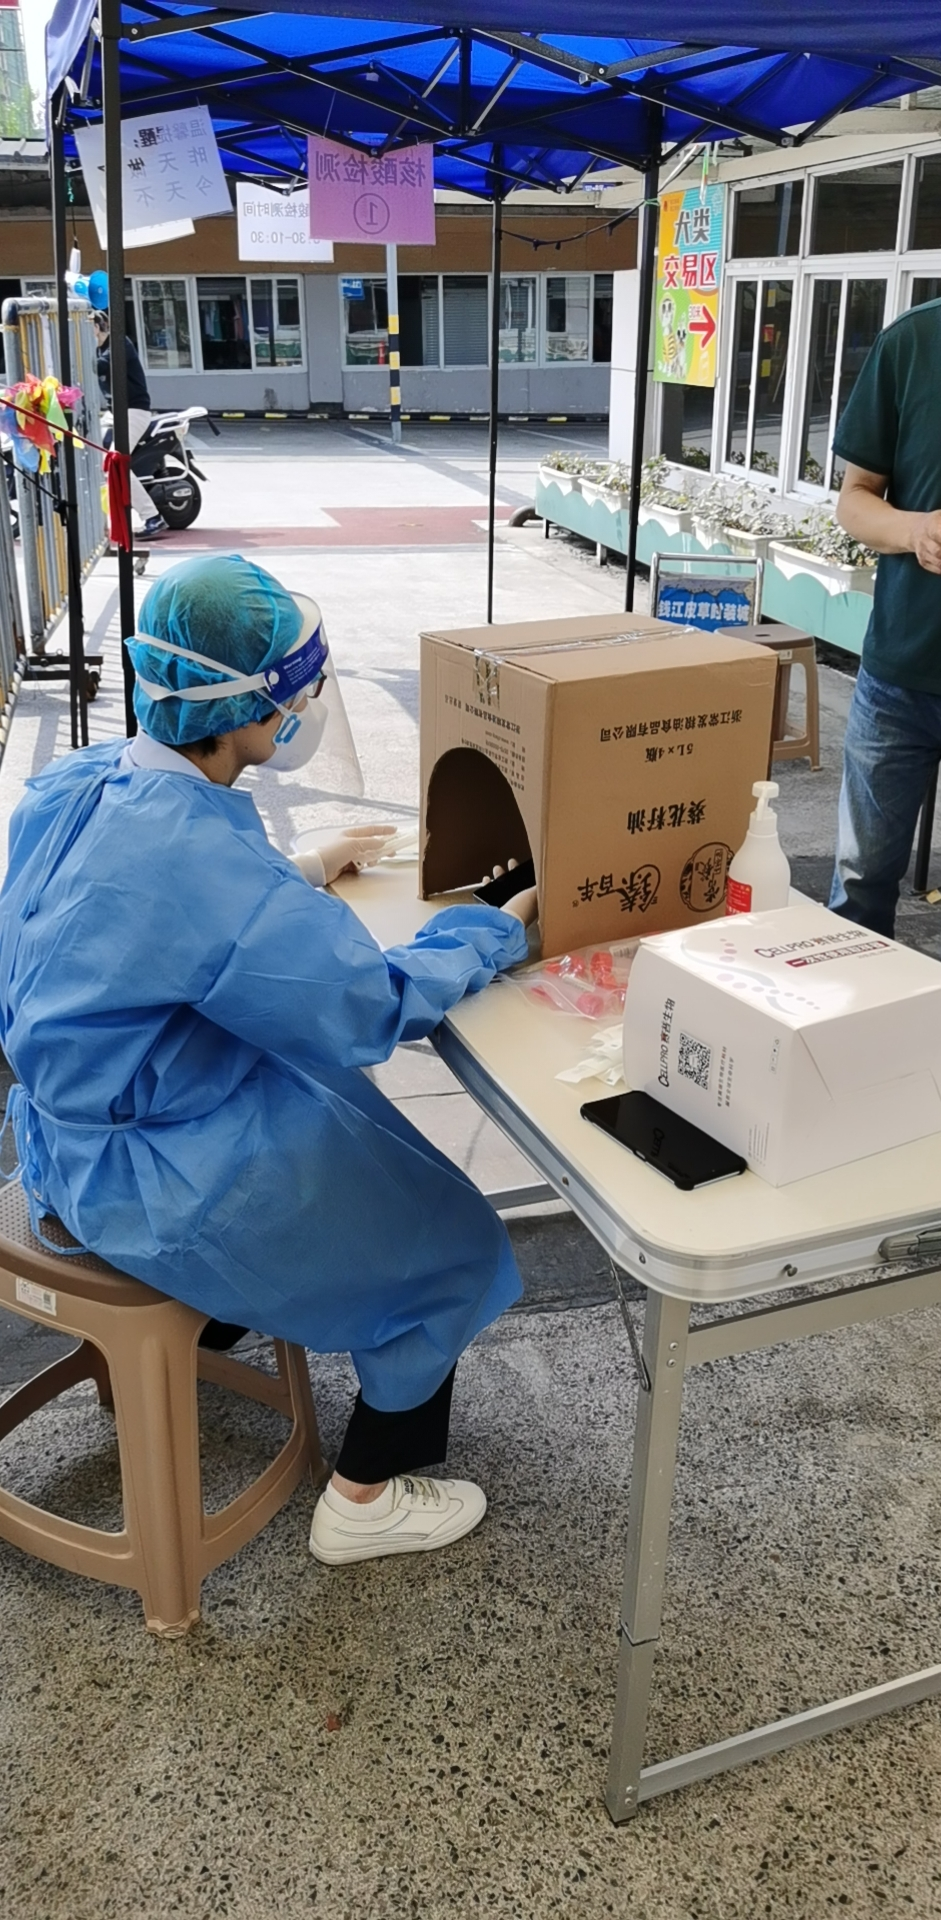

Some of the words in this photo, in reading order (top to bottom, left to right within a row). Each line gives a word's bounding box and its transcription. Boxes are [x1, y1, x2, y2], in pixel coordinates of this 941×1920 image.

[674, 207, 712, 246] 犬类
[663, 252, 719, 289] 交易区
[599, 708, 743, 742] 浙江常发粮油食品有限公司
[626, 798, 707, 835] 葵花籽油
[657, 1044, 671, 1088] CELLPRO
